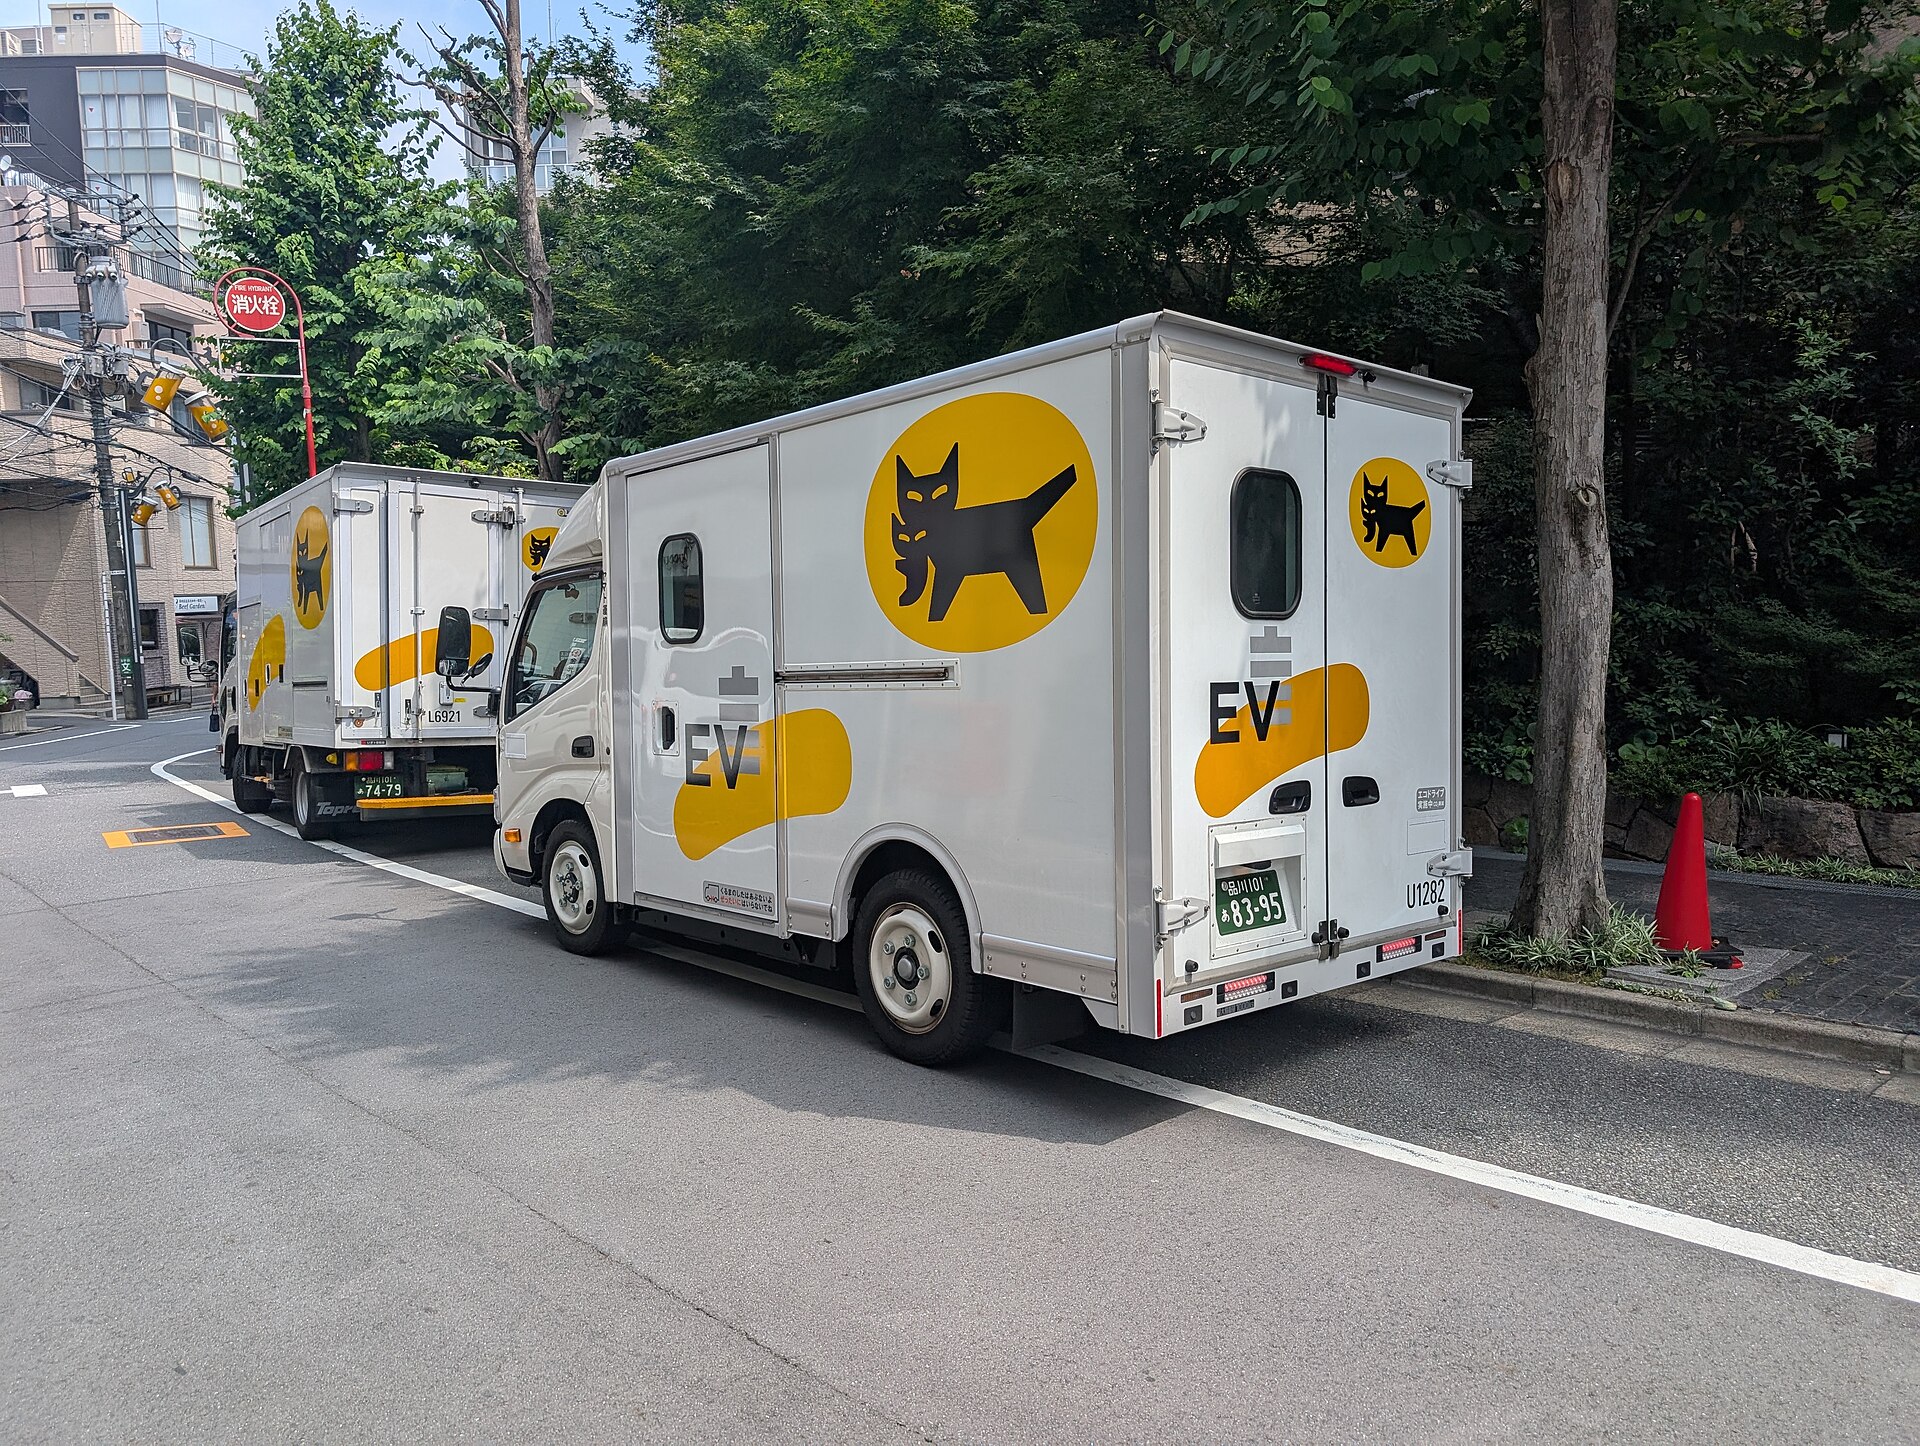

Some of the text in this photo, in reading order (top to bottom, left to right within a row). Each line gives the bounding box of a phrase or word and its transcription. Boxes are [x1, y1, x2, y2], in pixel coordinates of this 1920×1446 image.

[231, 293, 280, 315] 消火栓
[428, 710, 460, 723] L6921
[1209, 680, 1281, 745] EV
[684, 723, 748, 790] EV
[365, 783, 402, 798] 74-79
[1407, 879, 1445, 909] U1282
[1221, 892, 1282, 928] あ 83-95
